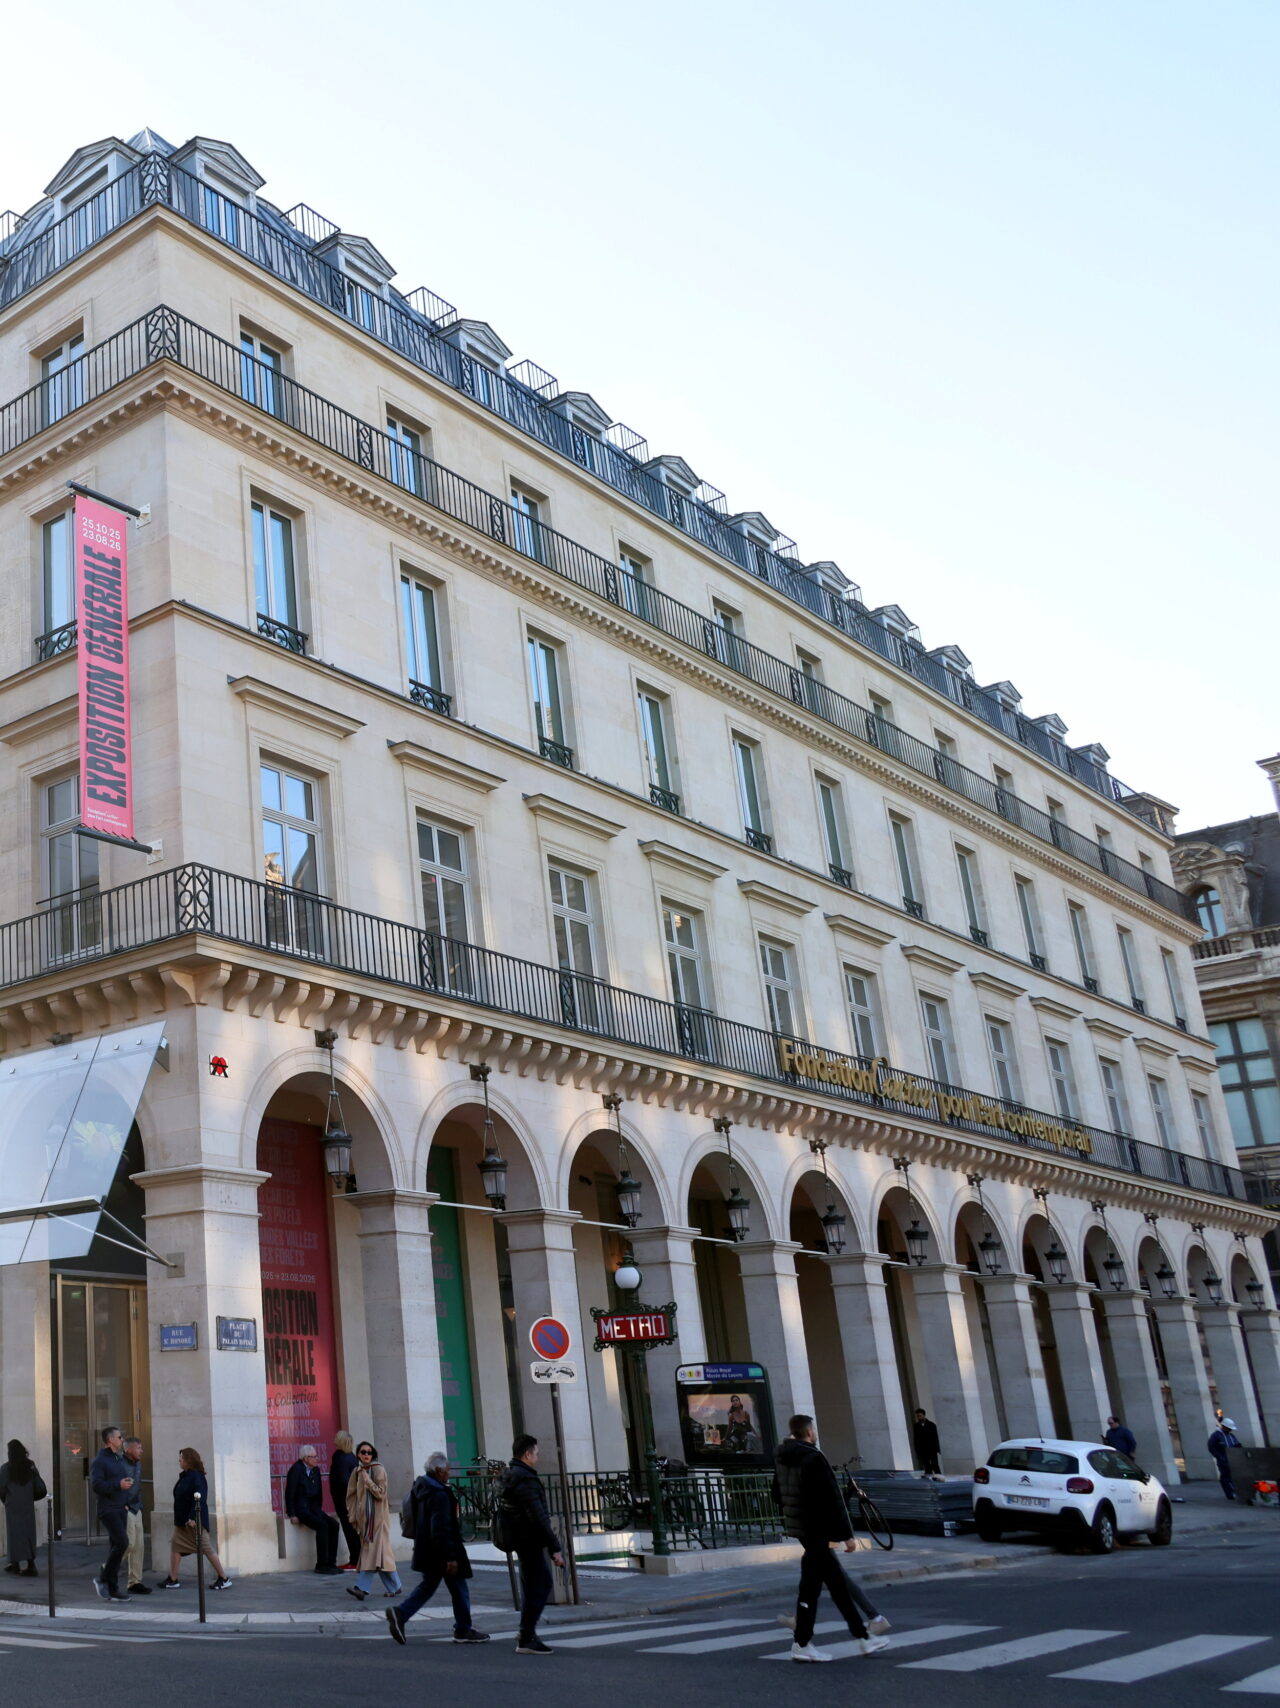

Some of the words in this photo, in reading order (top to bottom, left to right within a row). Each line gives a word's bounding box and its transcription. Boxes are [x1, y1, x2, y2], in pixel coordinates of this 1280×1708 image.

[82, 516, 121, 540] 25.10.25
[82, 528, 121, 551] 23.08.26
[83, 543, 123, 664] GÉNÉRALE
[86, 662, 127, 809] EXPOSITION
[778, 1038, 874, 1093] Fondation
[1006, 1111, 1094, 1154] contemporain
[262, 1287, 319, 1336] OSITION
[600, 1314, 666, 1339] METRO
[171, 1329, 184, 1337] RUE
[264, 1335, 316, 1386] NÉRALE
[279, 1418, 321, 1438] PAYSAGES
